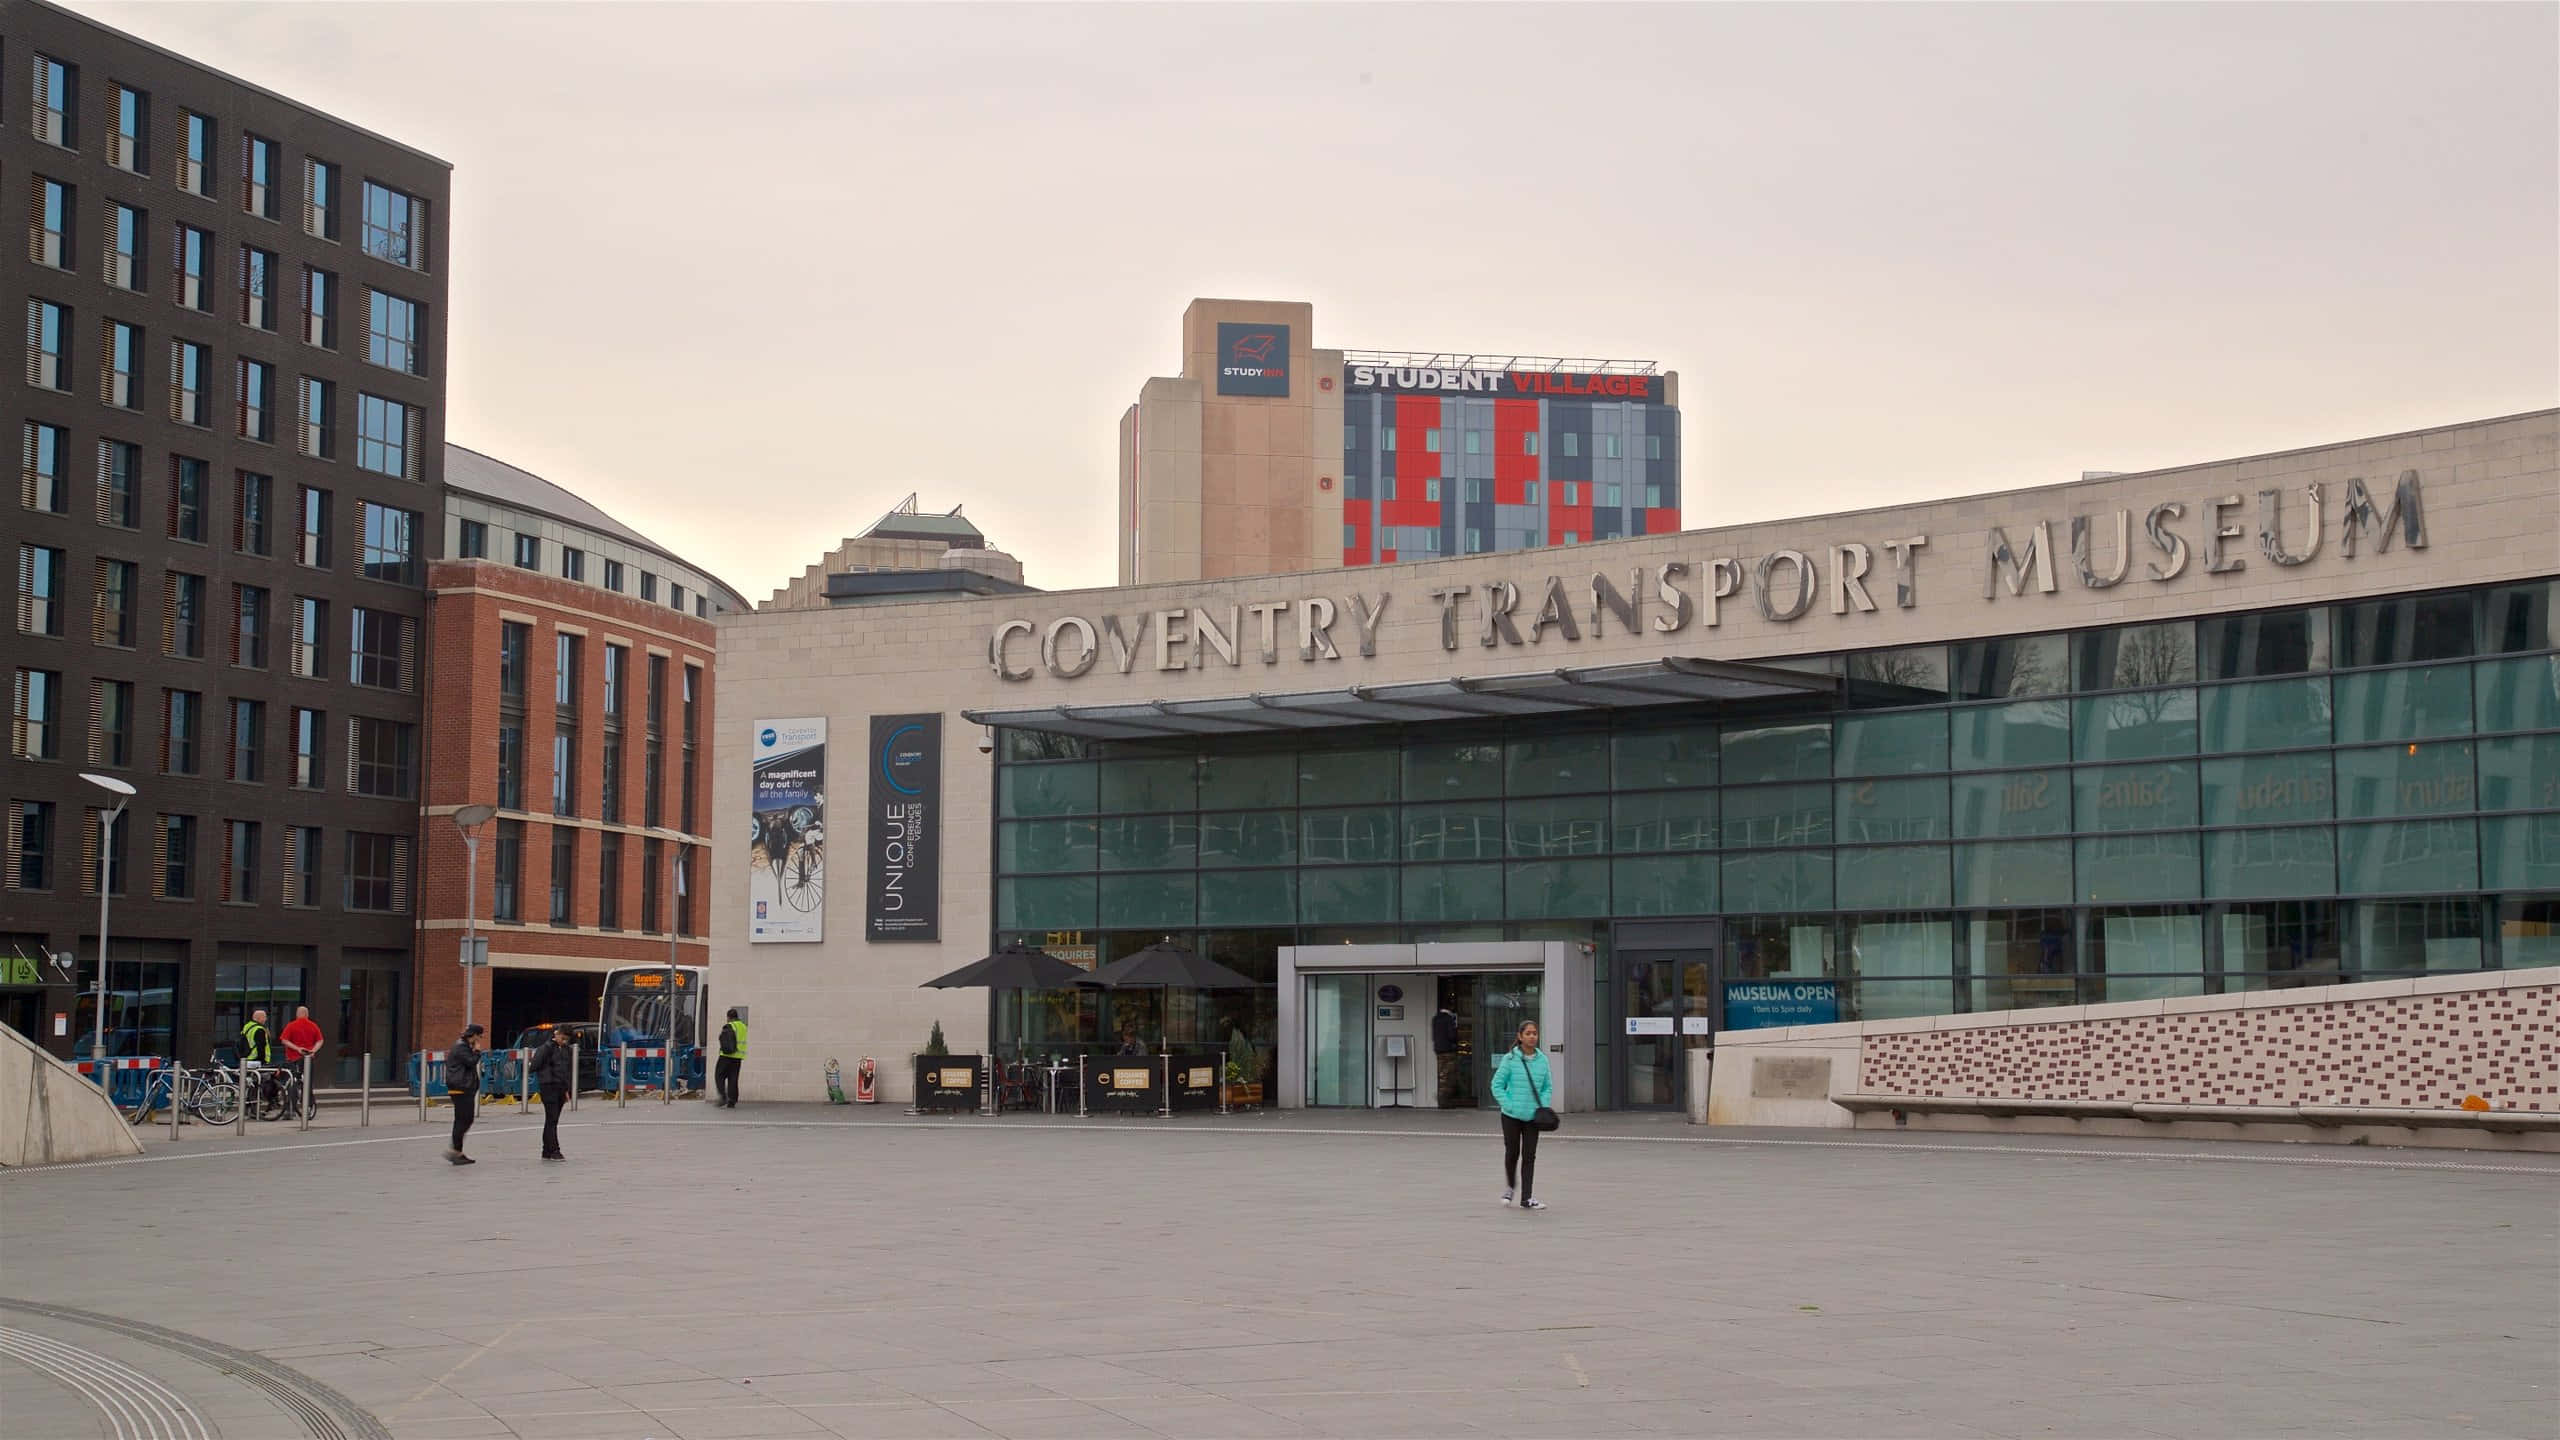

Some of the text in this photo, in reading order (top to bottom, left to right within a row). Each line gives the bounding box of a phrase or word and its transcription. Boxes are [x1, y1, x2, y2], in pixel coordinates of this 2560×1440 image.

[1354, 367, 1648, 397] STUDENT VILLAGE
[988, 469, 2429, 682] COVENTRY TRANSPORT MUSEUM
[768, 770, 817, 780] magnificent
[760, 781, 774, 789] day
[792, 780, 803, 788] for
[760, 789, 808, 799] all the family
[914, 802, 922, 841] VENUES
[906, 803, 915, 868] CONFERENCE
[1728, 986, 1835, 1000] MUSEUM OPEN
[1796, 1005, 1813, 1015] daily
